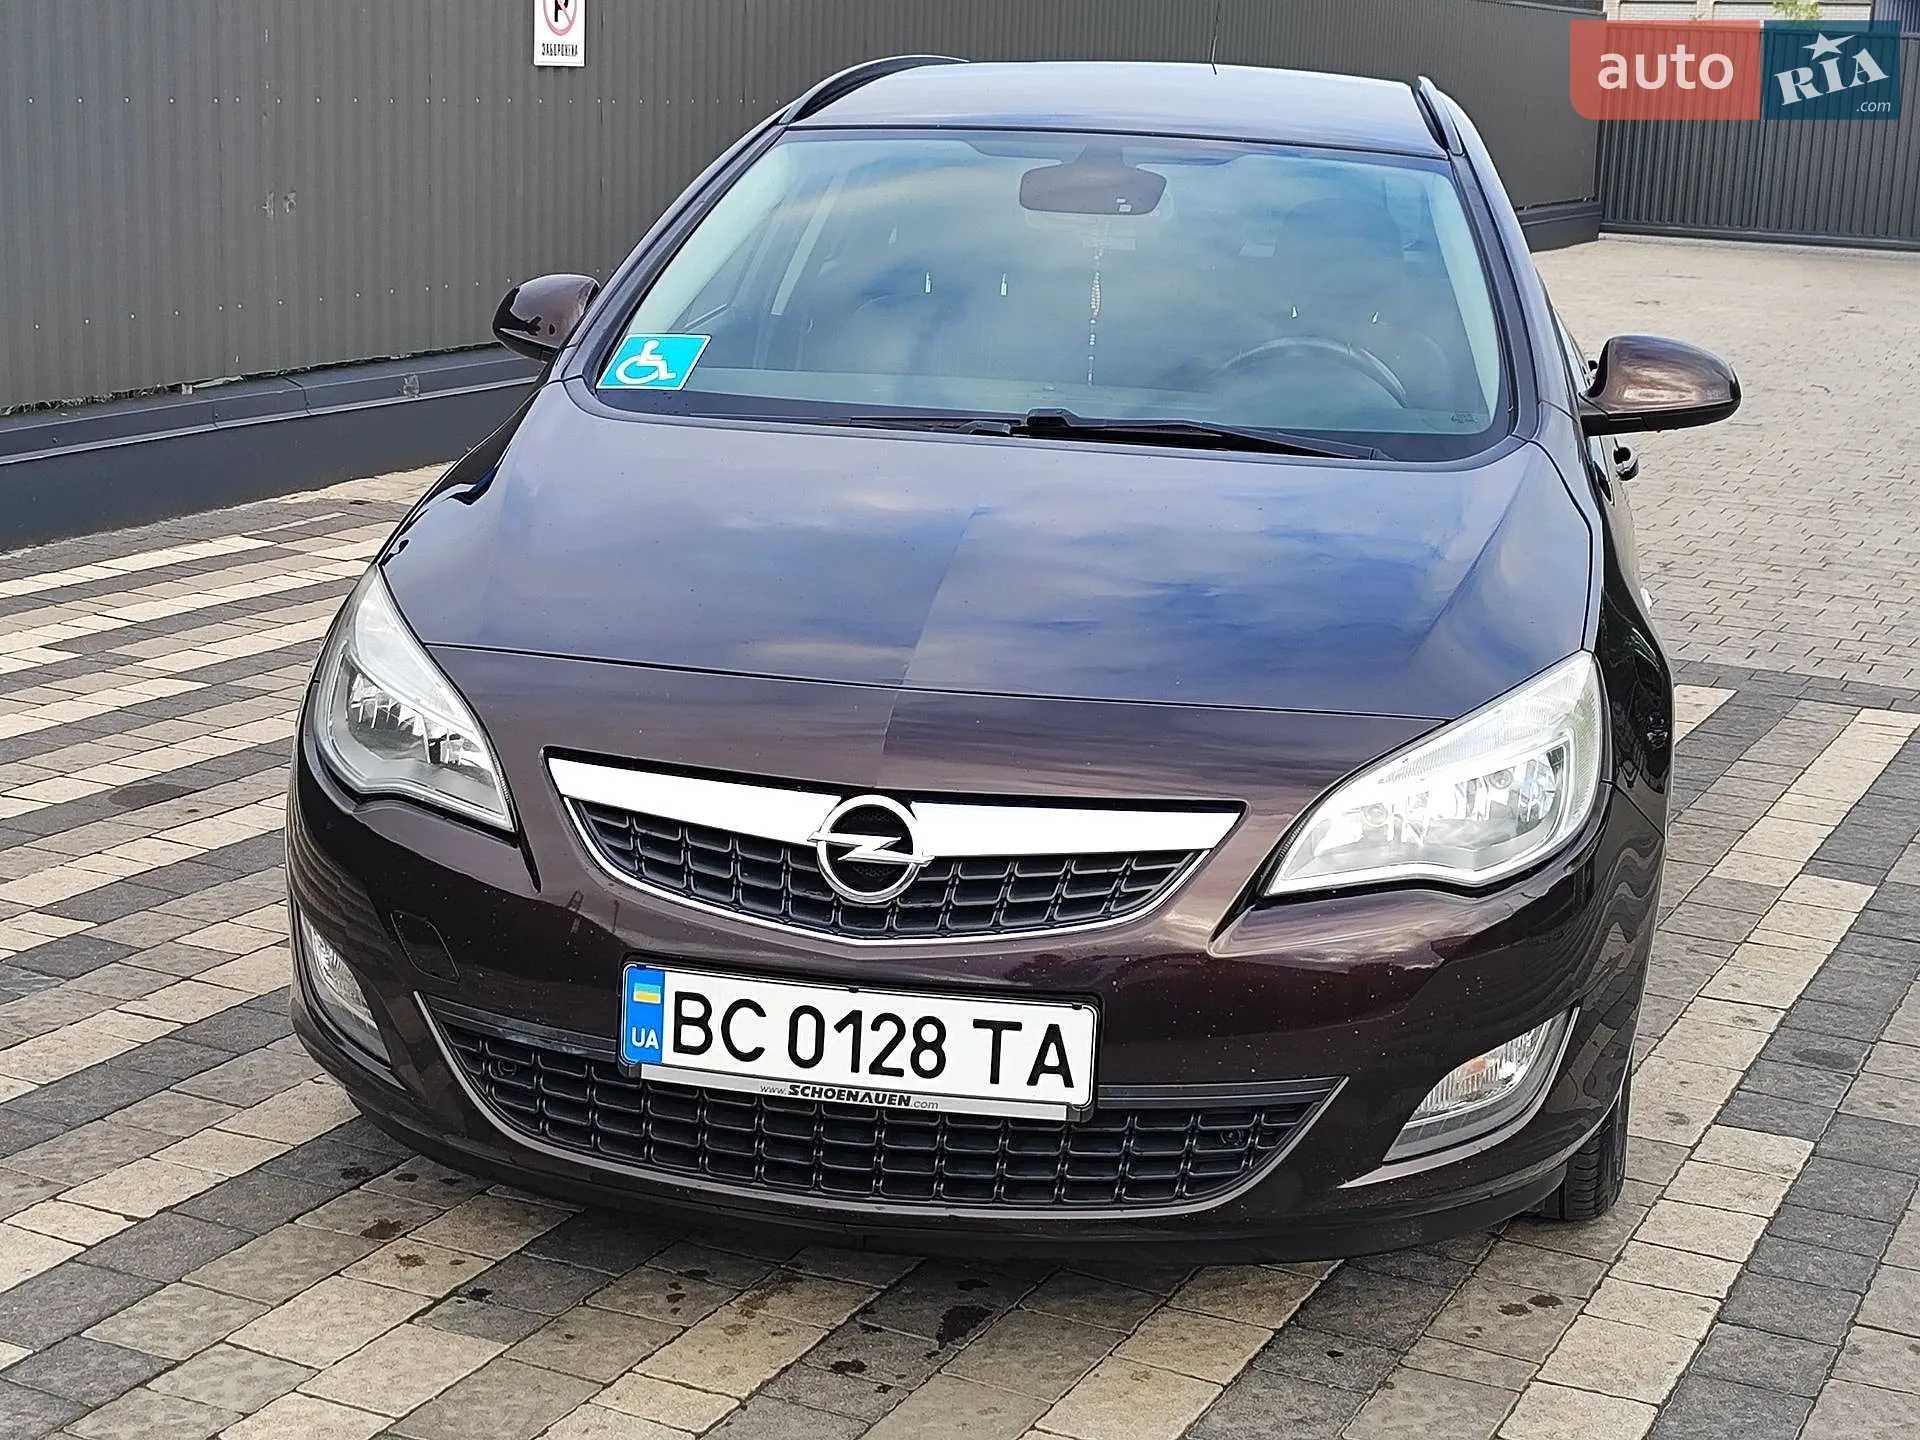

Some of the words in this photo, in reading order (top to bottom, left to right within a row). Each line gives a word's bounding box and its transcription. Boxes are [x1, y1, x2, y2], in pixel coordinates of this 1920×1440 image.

[631, 1027, 660, 1051] UA
[672, 990, 768, 1063] BC
[787, 1004, 947, 1080] 0128
[972, 1019, 1076, 1089] TA
